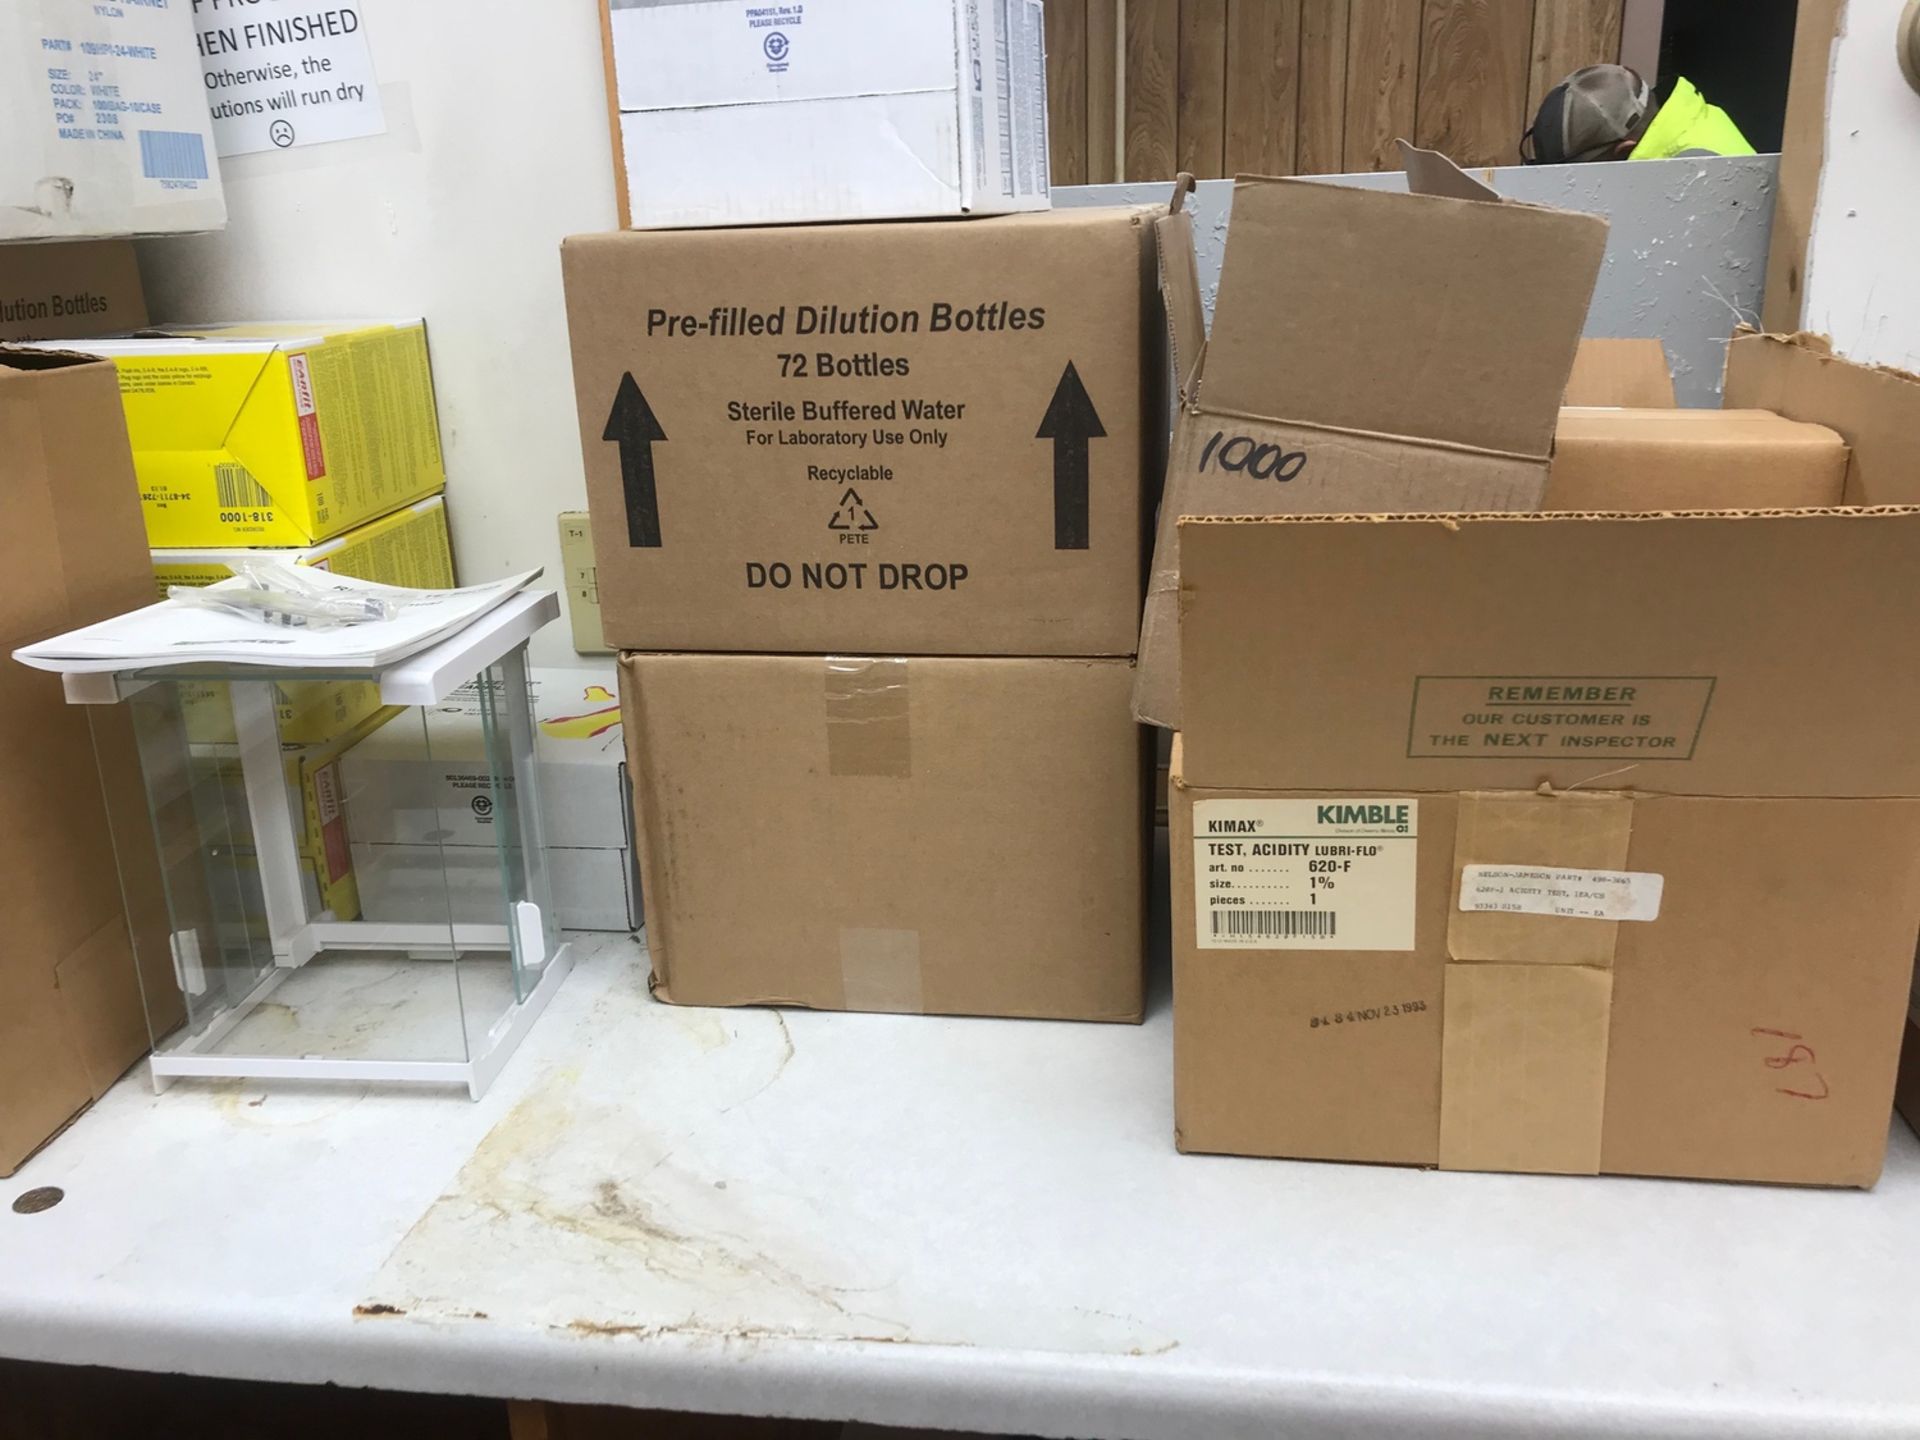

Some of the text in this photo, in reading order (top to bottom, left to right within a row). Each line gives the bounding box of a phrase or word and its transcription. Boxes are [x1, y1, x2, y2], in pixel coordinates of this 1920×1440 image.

[244, 8, 359, 49] FINISHED
[749, 16, 802, 28] PLEASE RECYCLE
[204, 56, 332, 89] Otherwise, the
[91, 85, 120, 97] WHITE
[267, 89, 298, 111] will
[301, 88, 331, 106] run
[336, 81, 364, 101] dry
[97, 129, 125, 140] CHINA
[52, 291, 108, 317] Bottles
[647, 300, 1046, 336] Pre-filled Dilution Bottles
[777, 352, 910, 378] 72 Bottles
[727, 400, 966, 421] Sterile Buffered Water
[746, 429, 948, 448] For Laboratory Use Only
[1199, 431, 1307, 482] 1000
[807, 465, 893, 483] Recyclable
[220, 511, 274, 523] 318-1000
[839, 533, 869, 545] PETE
[746, 563, 968, 590] DO NOT DROP
[1488, 686, 1637, 701] REMEMBER
[1462, 713, 1651, 726] OUR CUSTOMER IS
[1430, 733, 1676, 748] THE NEXT INSPECTOR
[1317, 805, 1409, 824] KIMBLE
[1208, 843, 1247, 857] TEST,
[1252, 843, 1310, 857] ACIDITY
[1209, 860, 1351, 873] art. no 620-F
[1310, 876, 1335, 890] 1%
[1210, 892, 1317, 906] pieces 1
